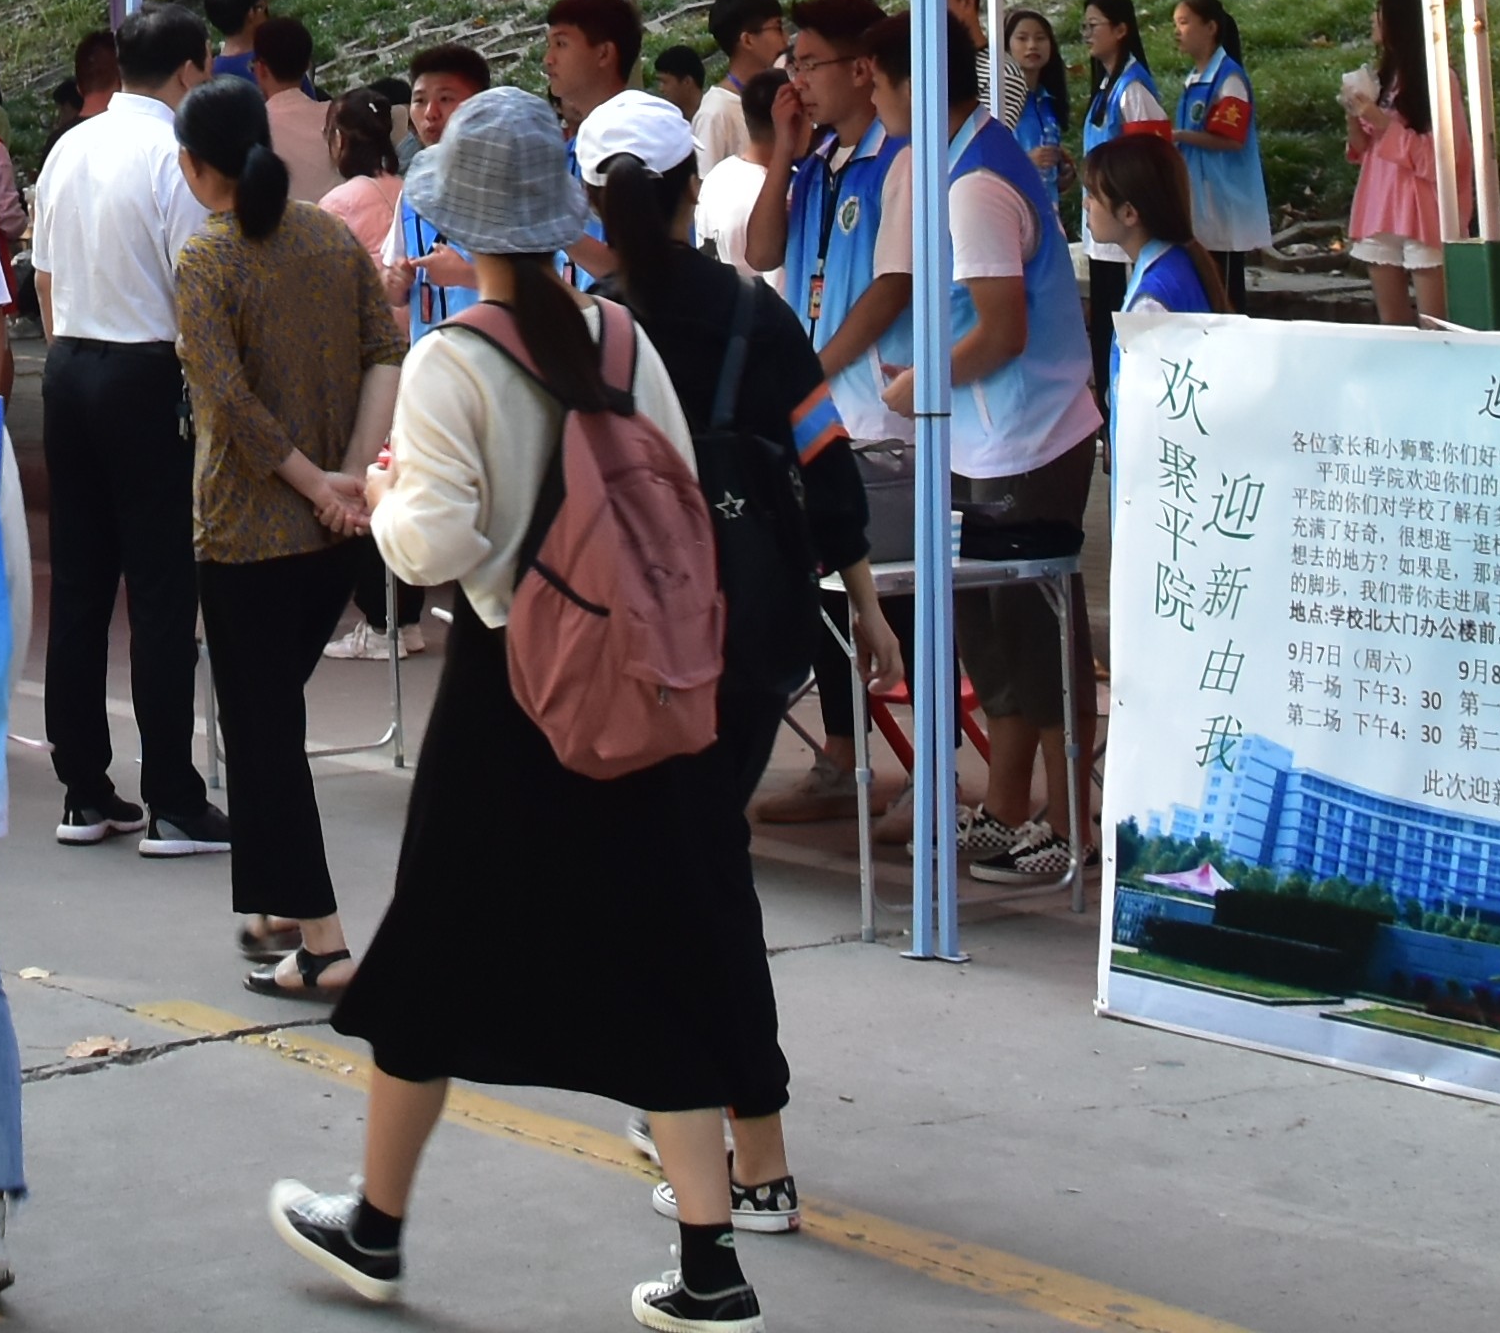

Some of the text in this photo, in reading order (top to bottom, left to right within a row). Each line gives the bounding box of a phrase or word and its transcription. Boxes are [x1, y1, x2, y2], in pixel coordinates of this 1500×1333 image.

[1287, 668, 1343, 700] 第一场
[1286, 701, 1342, 733] 第二场
